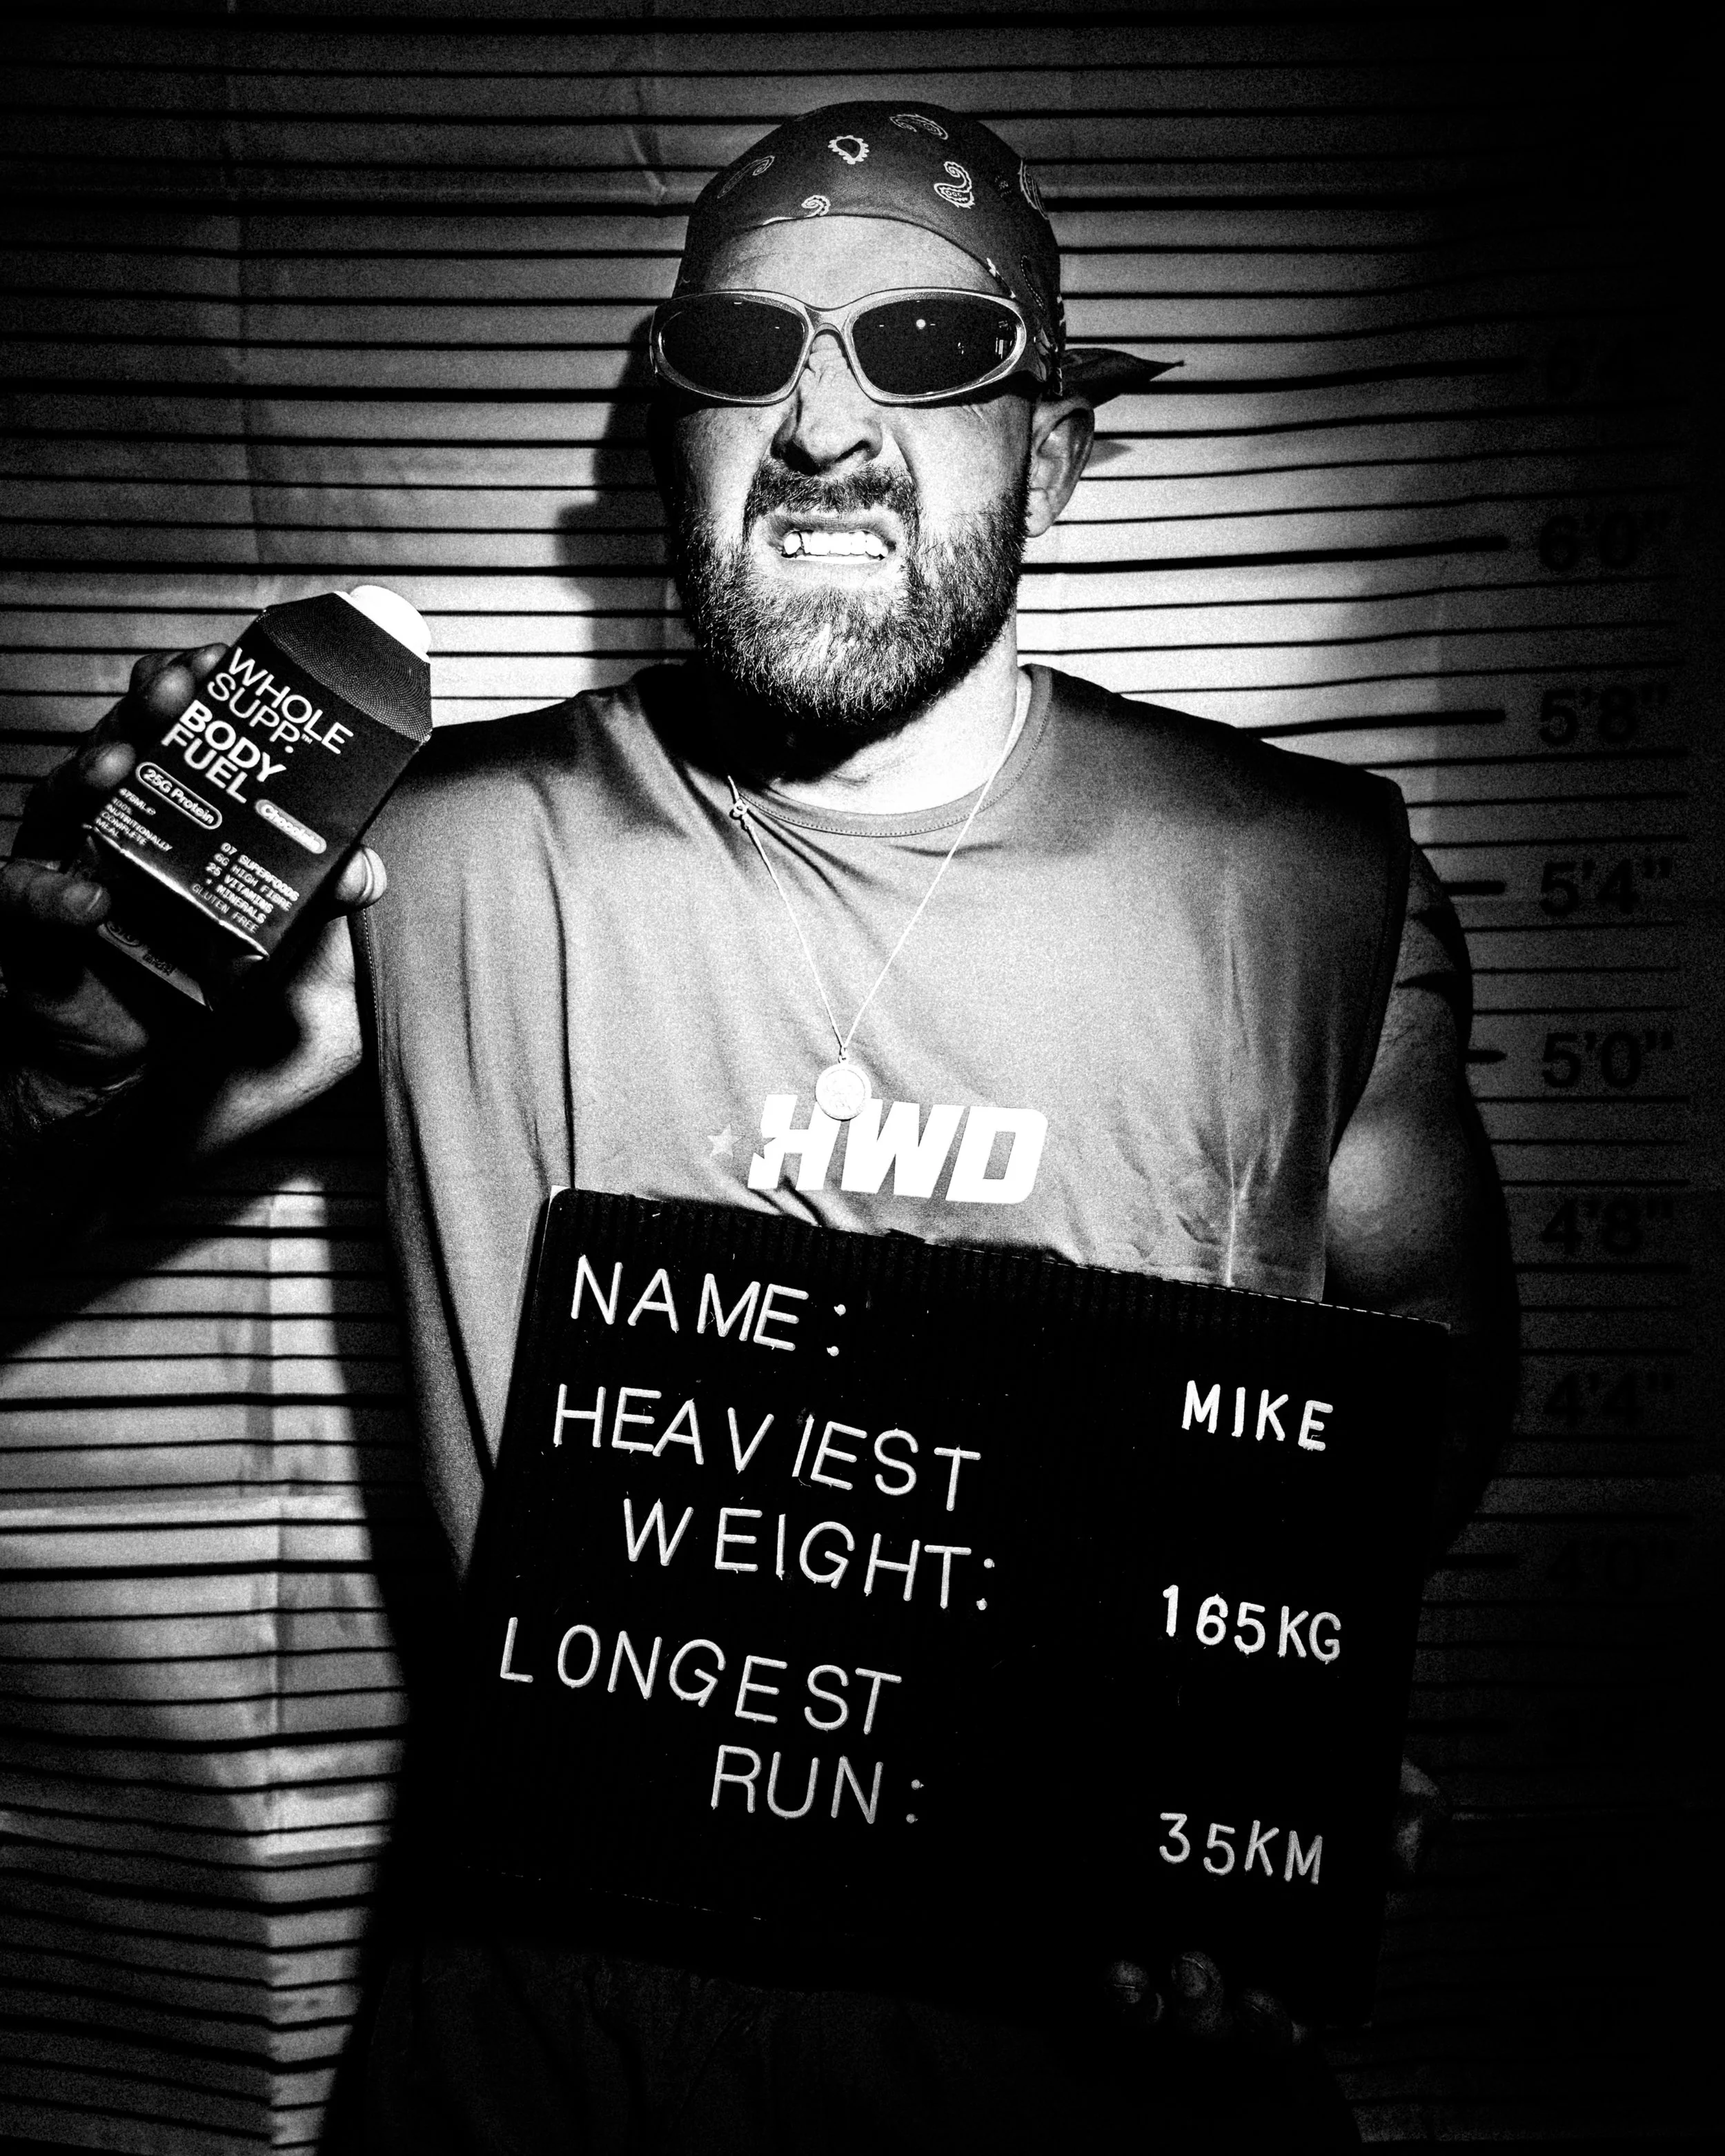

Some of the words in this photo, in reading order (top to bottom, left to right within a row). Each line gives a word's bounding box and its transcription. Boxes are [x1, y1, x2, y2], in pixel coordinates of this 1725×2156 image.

[228, 646, 354, 755] WHOLE
[161, 722, 248, 804] FUEL
[179, 699, 287, 782] BODY
[94, 816, 119, 838] MEAL
[99, 811, 148, 846] COMPLETE
[104, 803, 173, 852] NUTRITIONALLY
[144, 768, 172, 793] 25G
[170, 787, 215, 824] Protein
[204, 862, 223, 877] 25
[224, 873, 274, 914] VITAMINS
[215, 884, 267, 924] MINERALS
[220, 842, 238, 856] 07
[237, 854, 300, 902] SUPERFOODS
[230, 864, 259, 887] HIGH
[259, 884, 293, 912] FIBRE
[190, 882, 230, 914] GLUTEN
[231, 911, 259, 933] FREE
[747, 1094, 1049, 1205] HWD
[553, 1384, 981, 1512] HEAVIEST
[1182, 1380, 1334, 1452] MIKE
[624, 1498, 995, 1610] WEIGHT:
[1163, 1585, 1341, 1665] 165KG
[500, 1617, 902, 1735] LONGEST
[1159, 1812, 1323, 1884] 35KM
